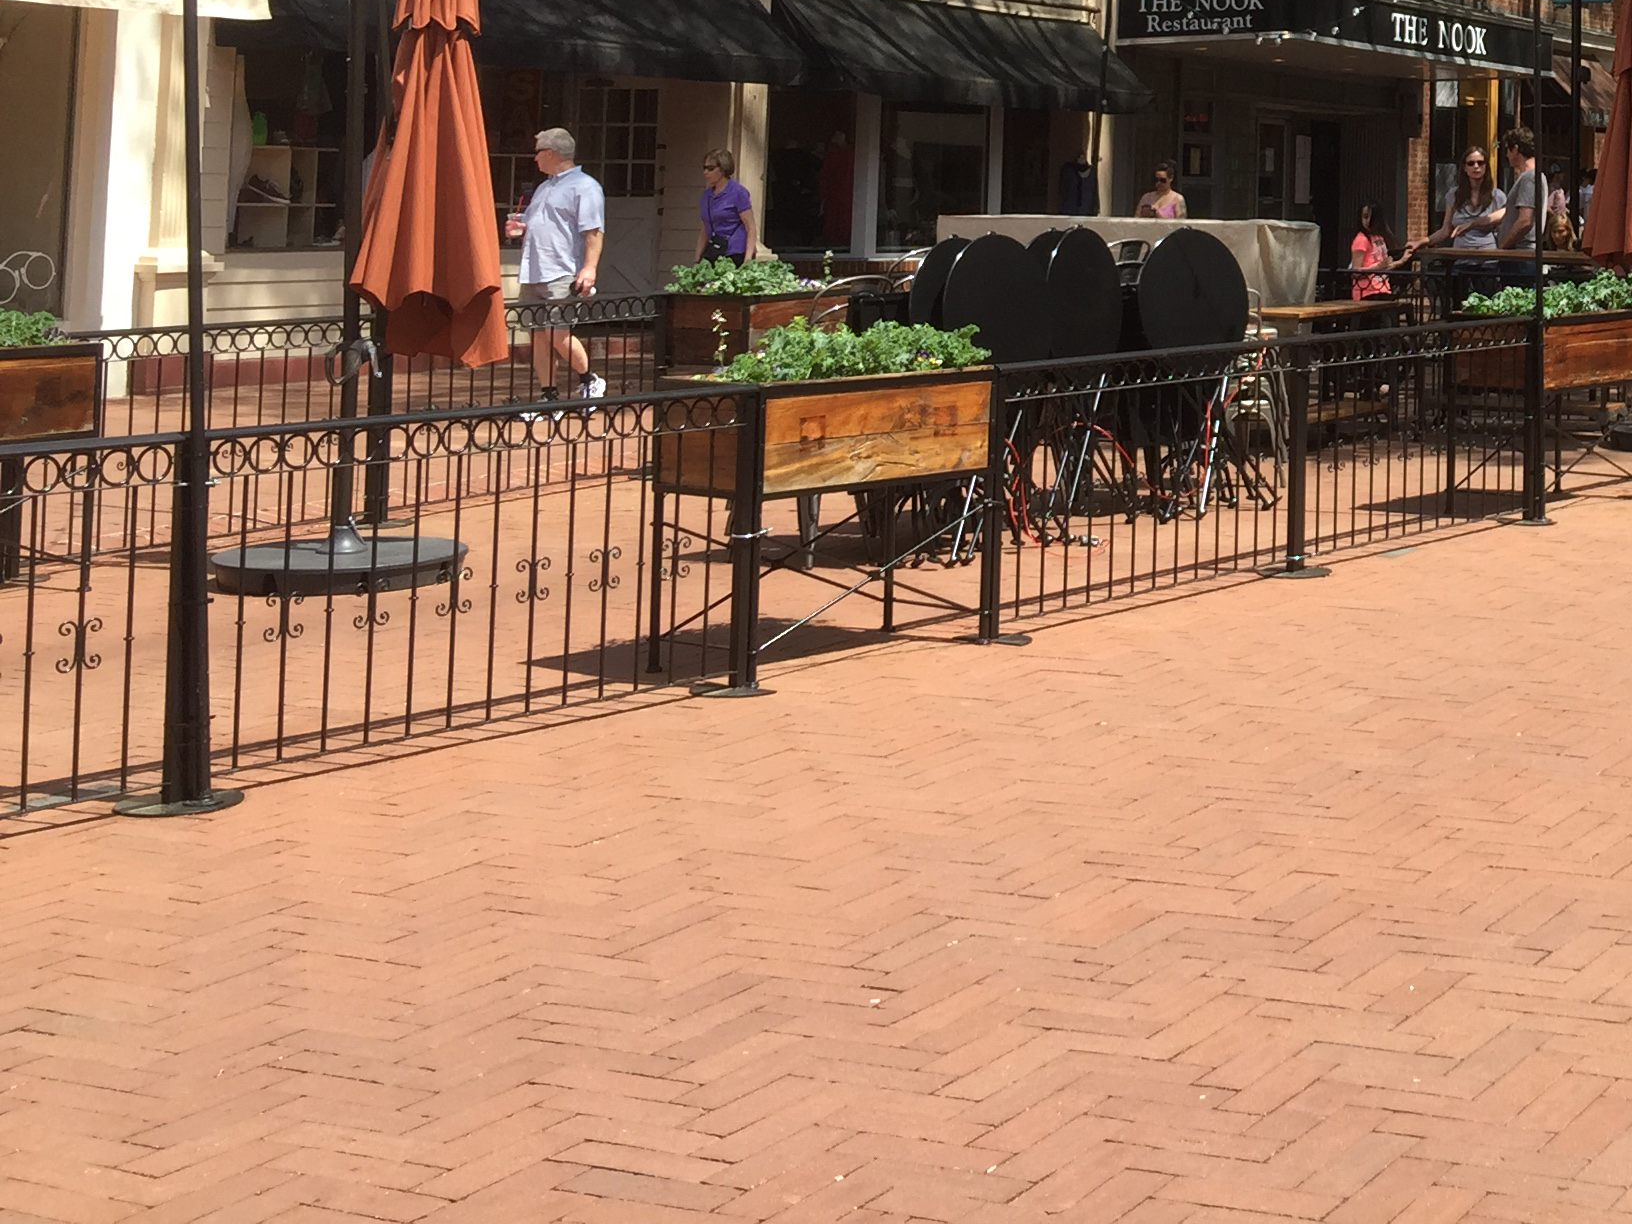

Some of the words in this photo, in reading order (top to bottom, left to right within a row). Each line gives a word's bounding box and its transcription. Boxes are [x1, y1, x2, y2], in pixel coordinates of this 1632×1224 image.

[1147, 14, 1252, 32] Restaurant
[1391, 13, 1428, 44] THE
[1438, 23, 1487, 55] NOOK
